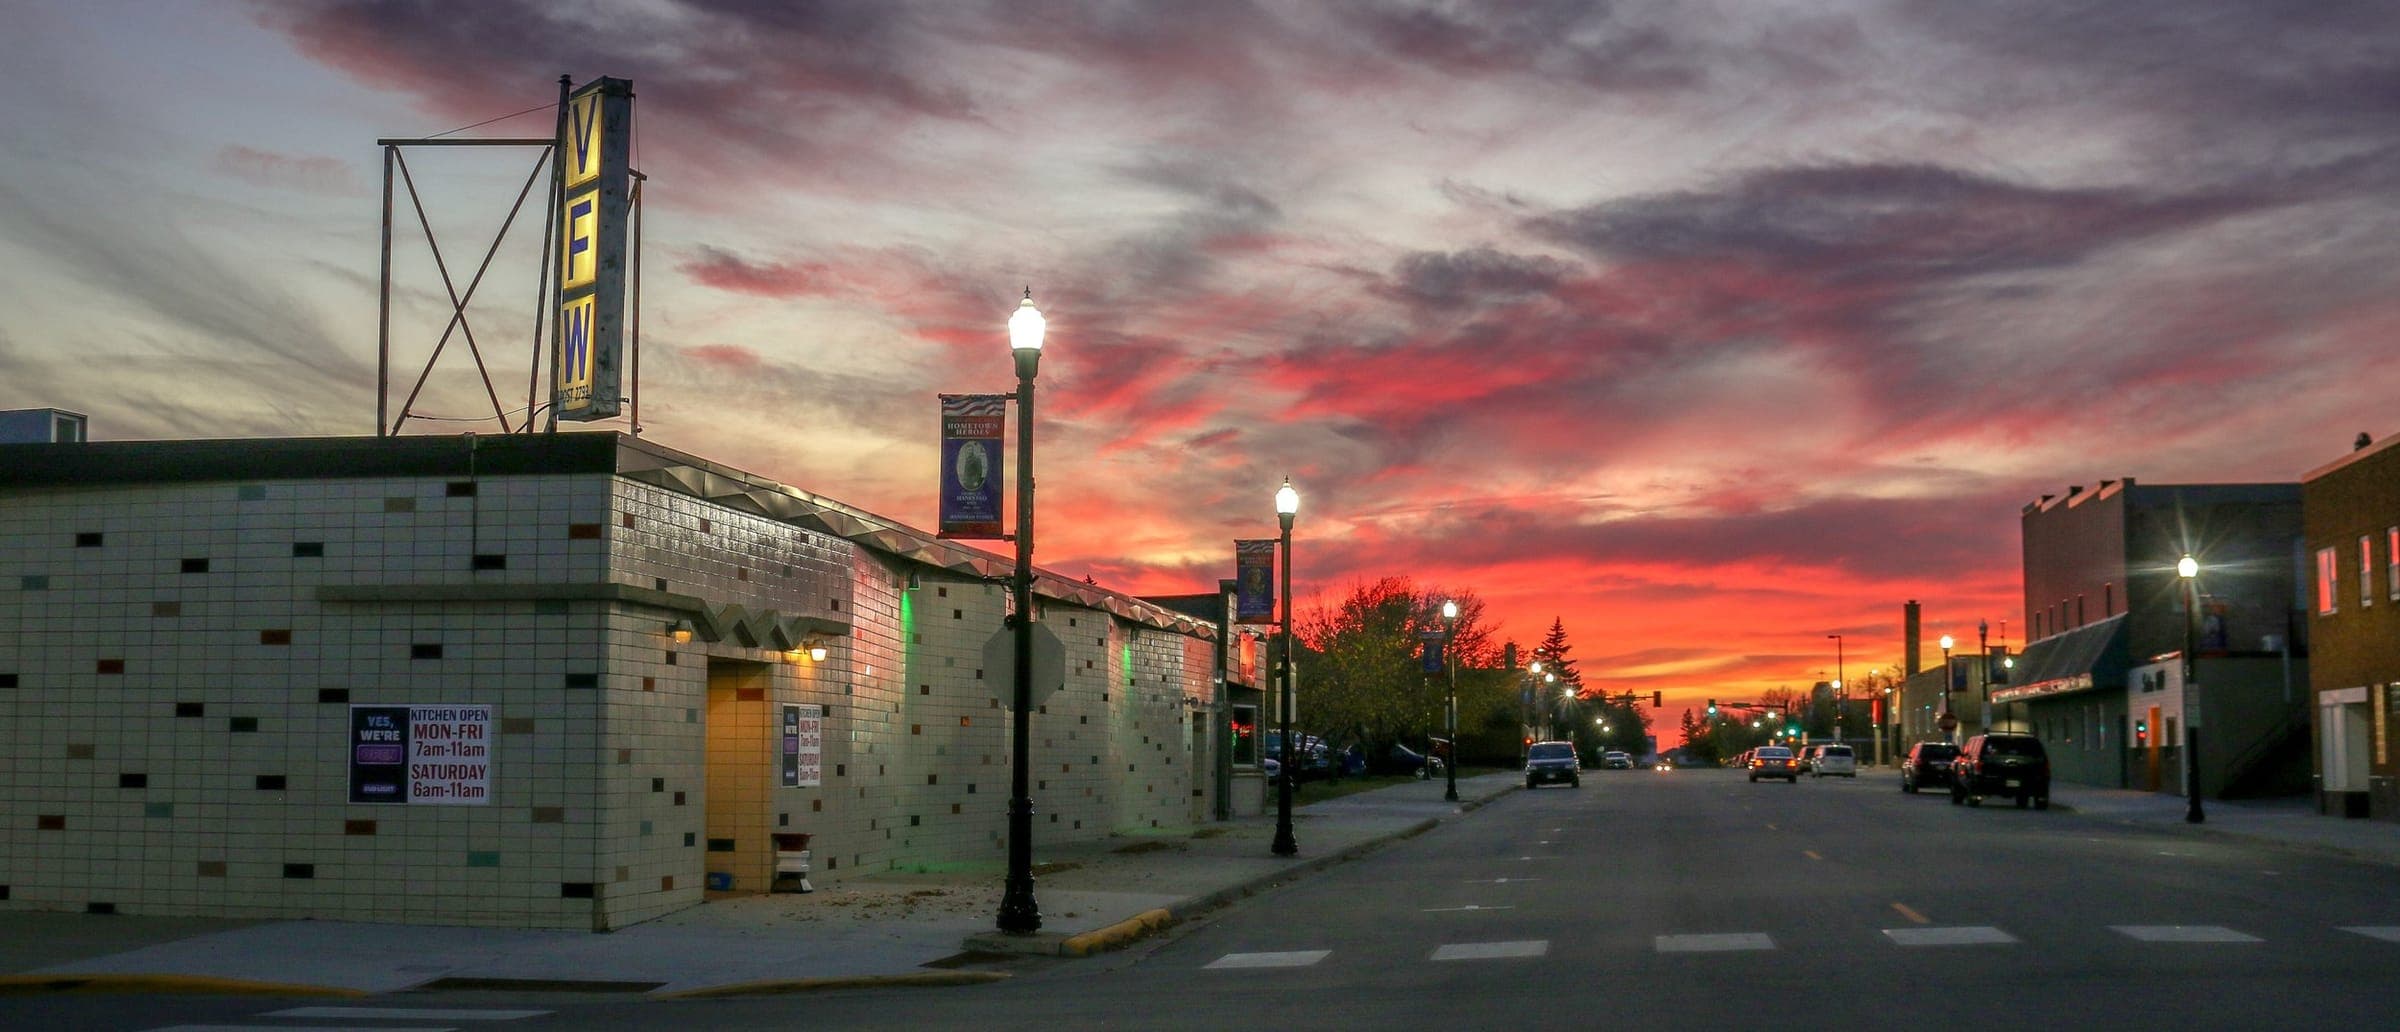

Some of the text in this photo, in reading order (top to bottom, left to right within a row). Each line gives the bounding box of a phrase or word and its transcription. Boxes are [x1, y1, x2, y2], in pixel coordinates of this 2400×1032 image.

[367, 716, 394, 729] YES,
[411, 709, 488, 721] KITCHEN OPEN
[360, 730, 400, 741] WE'RE
[414, 724, 483, 740] MON-FRI
[415, 741, 485, 757] 7am-11am
[411, 764, 487, 780] SATURDAY
[413, 781, 485, 798] 6am-11am
